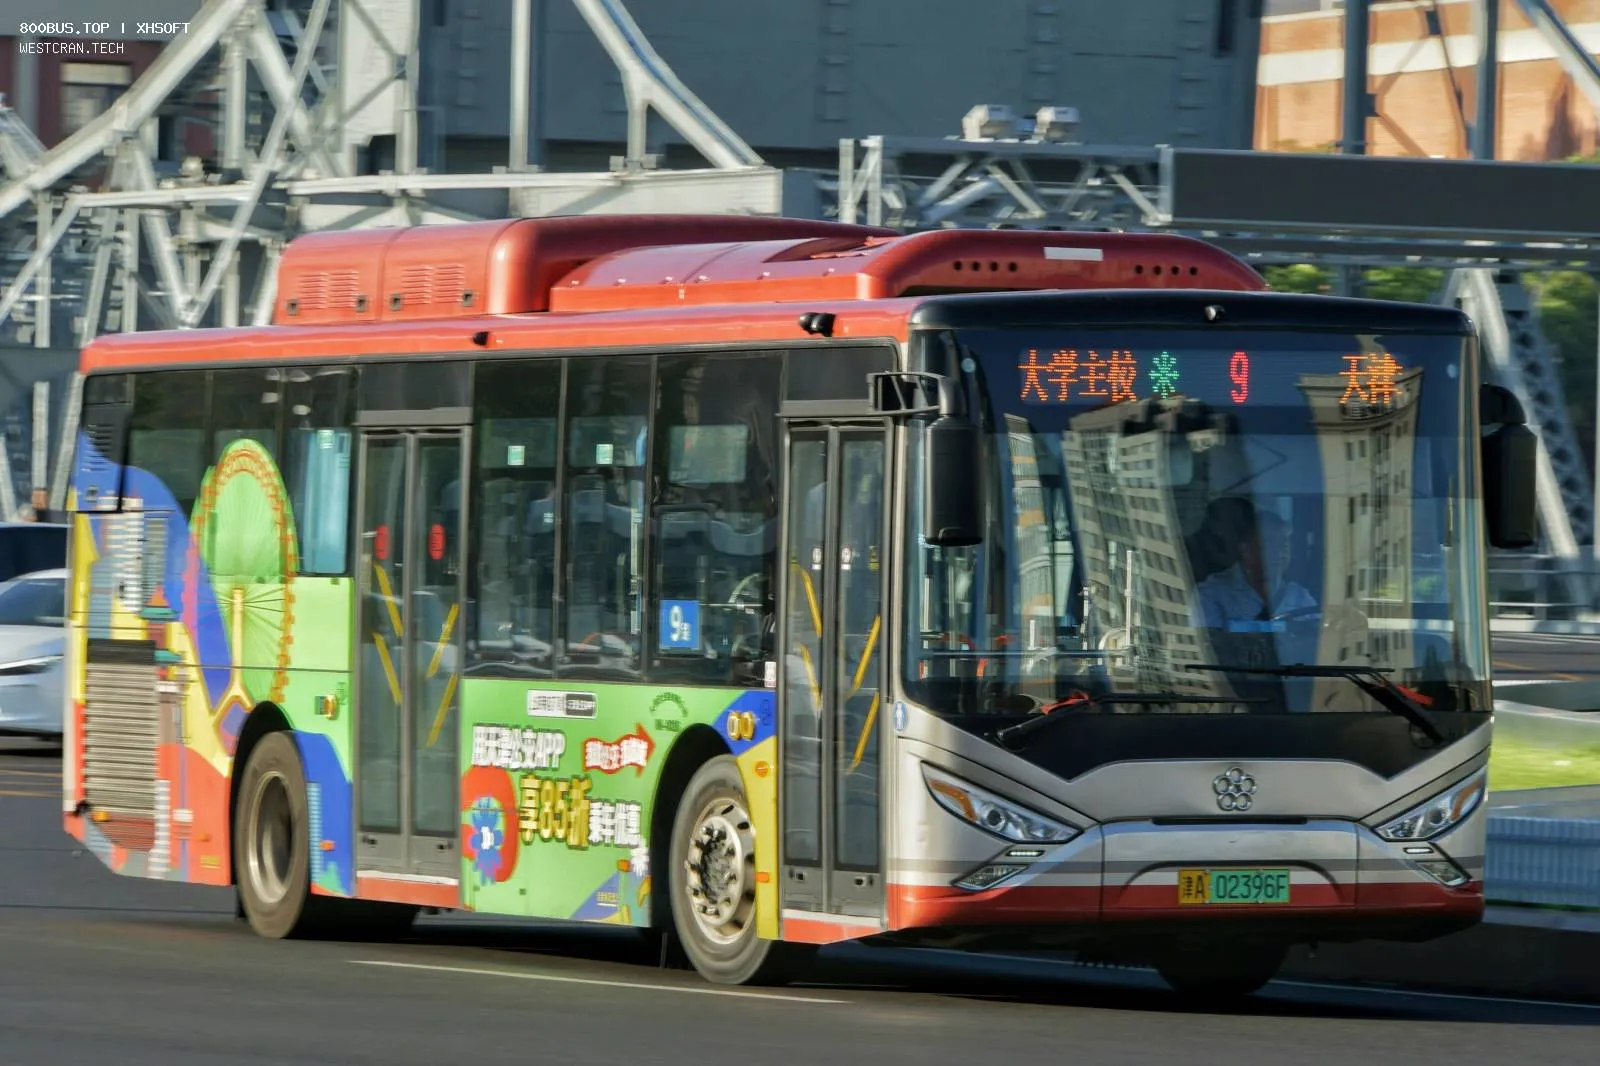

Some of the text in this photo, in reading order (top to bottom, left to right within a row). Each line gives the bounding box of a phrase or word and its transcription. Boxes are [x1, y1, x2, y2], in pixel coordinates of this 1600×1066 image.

[1018, 349, 1137, 402] 大学主校
[1230, 351, 1249, 403] 9
